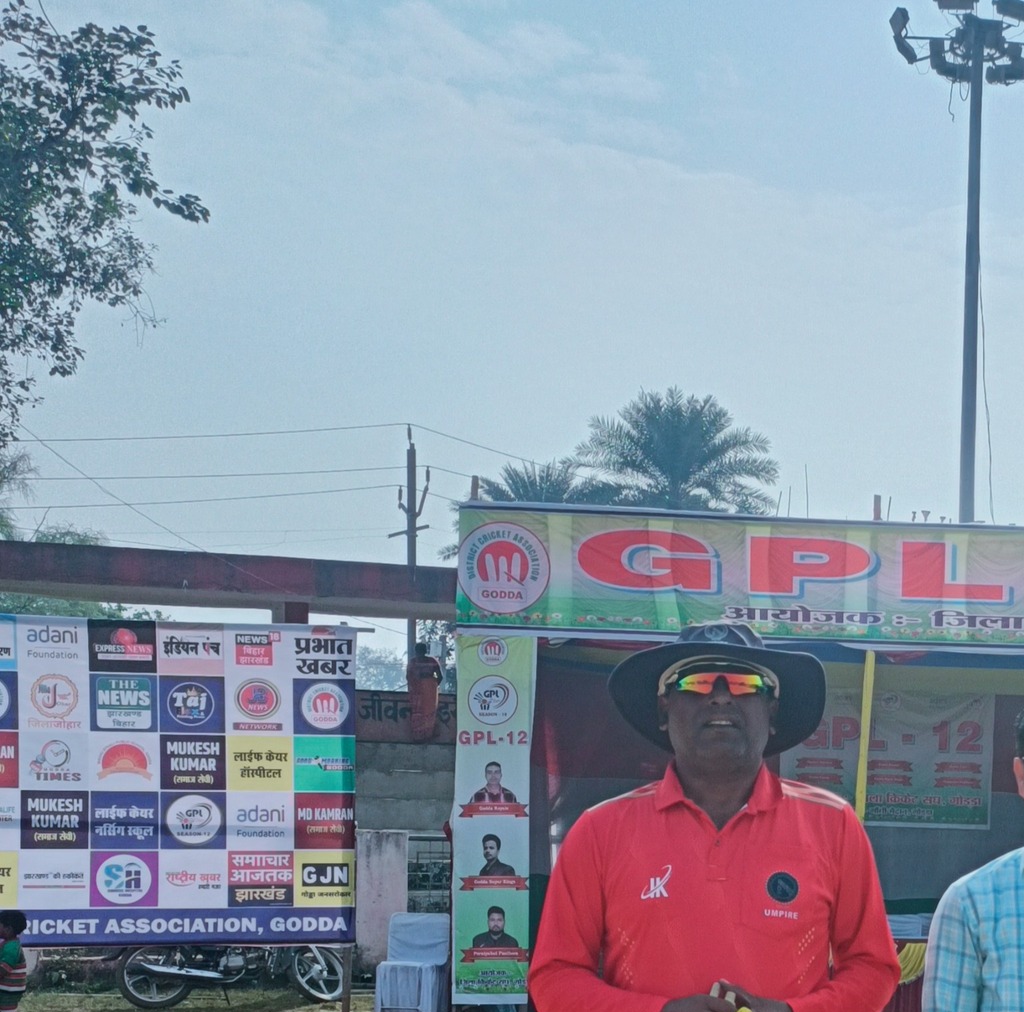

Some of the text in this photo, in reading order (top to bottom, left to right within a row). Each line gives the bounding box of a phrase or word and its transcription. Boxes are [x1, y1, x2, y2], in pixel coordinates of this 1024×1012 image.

[466, 530, 540, 581] DISTRICT CRICKET ASSOCIATION
[577, 529, 1013, 603] GPL
[481, 590, 523, 600] GODDA
[723, 604, 884, 625] आयोजक
[27, 625, 78, 644] adani
[237, 635, 268, 644] NEWS
[95, 644, 153, 654] EXPRESS NEWS
[163, 635, 199, 657] इंडियन
[294, 638, 353, 655] प्रभात
[27, 650, 78, 659] Foundation
[296, 658, 352, 675] खबर
[108, 679, 139, 689] THE
[98, 690, 150, 706] NEWS
[172, 692, 208, 710] Taj
[483, 689, 499, 699] GPL
[458, 730, 528, 746] GPL-12
[932, 719, 983, 753] 12
[167, 741, 220, 756] MUKESH
[233, 749, 288, 763] लाईफ केयर
[170, 757, 216, 772] KUMAR
[35, 772, 82, 782] TIMES
[27, 798, 83, 812] MUKESH
[95, 805, 154, 820] लाईफ केयर
[31, 814, 80, 828] KUMAR
[236, 805, 285, 822] adani
[297, 808, 354, 820] MD KAMRAN
[127, 825, 153, 841] स्कूल
[236, 830, 285, 838] Foundation
[230, 869, 293, 882] आजतक
[303, 866, 348, 884] GJN
[235, 886, 287, 903] झारखंड
[764, 909, 799, 920] UMPIRE
[104, 917, 264, 935] ASSOCIATION,
[270, 917, 347, 932] GODDA
